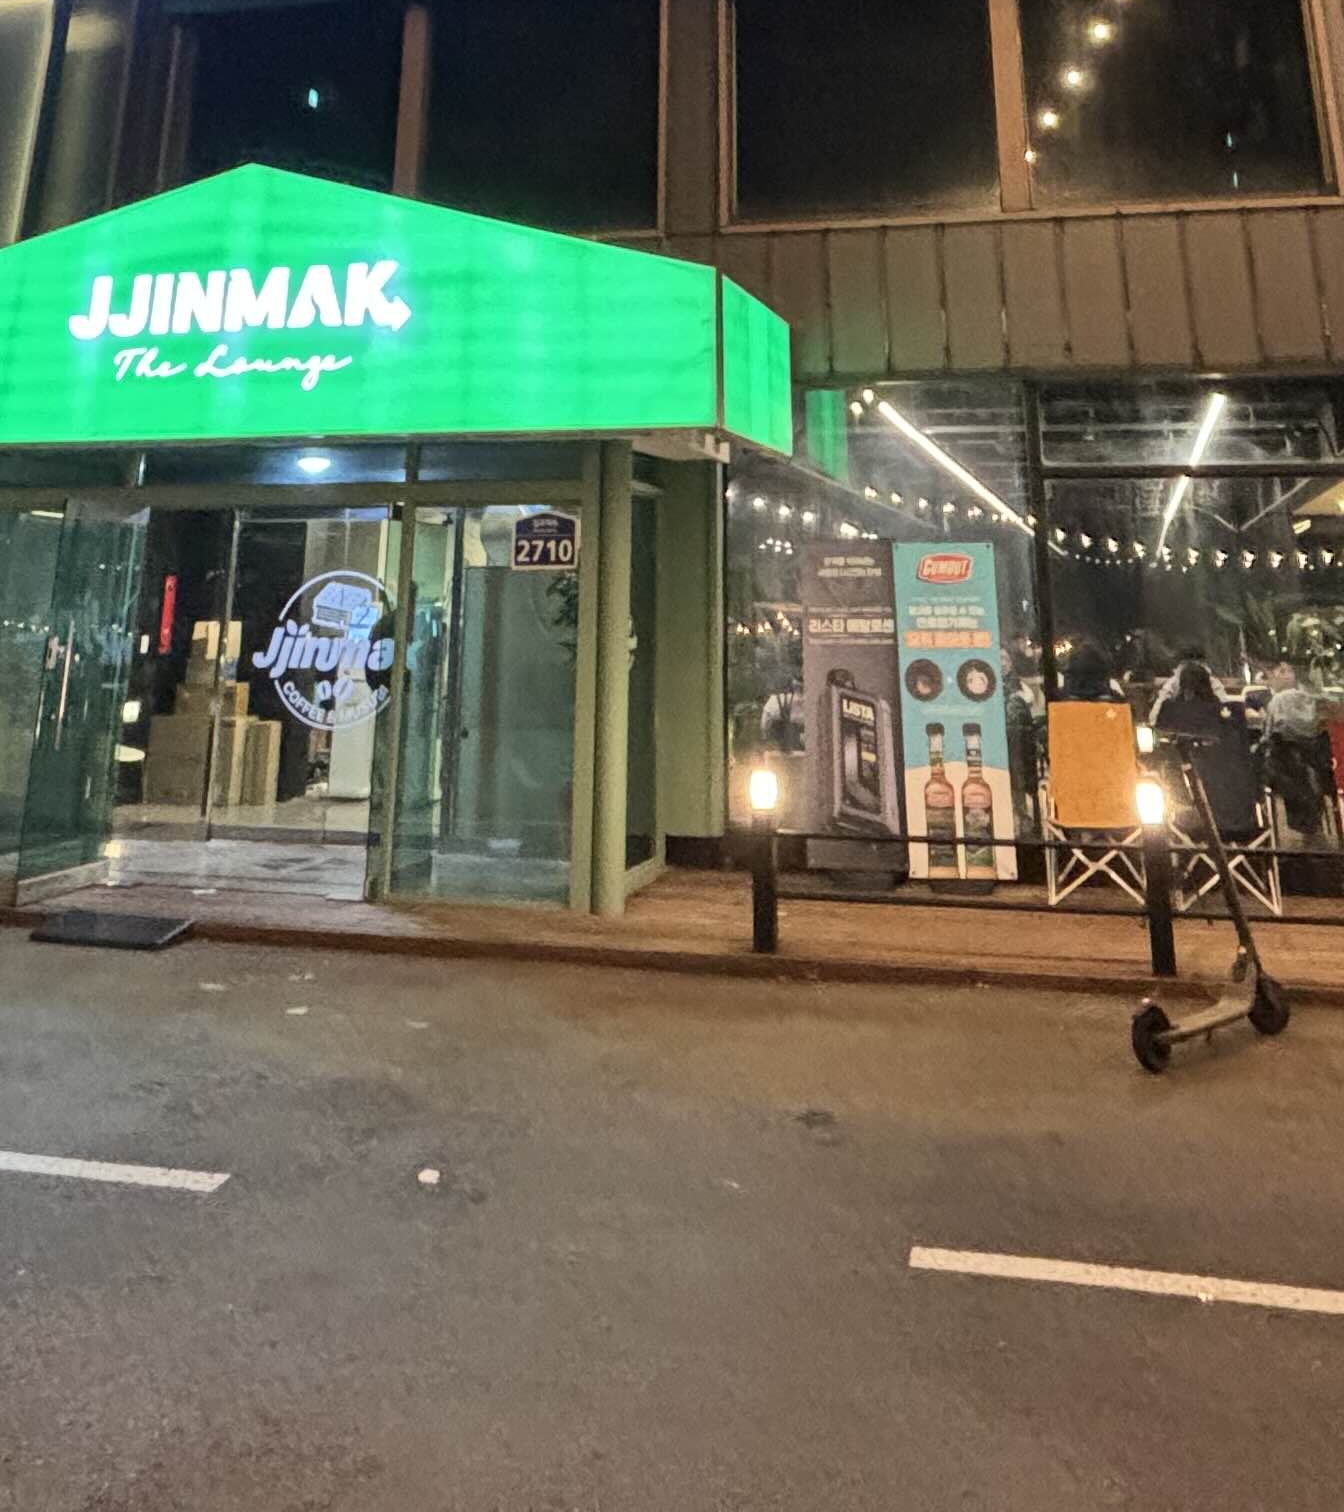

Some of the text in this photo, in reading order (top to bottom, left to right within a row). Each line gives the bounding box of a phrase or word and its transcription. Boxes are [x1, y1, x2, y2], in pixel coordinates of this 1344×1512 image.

[68, 260, 412, 339] JJINMAK
[113, 344, 352, 391] The Lounge
[517, 539, 573, 562] 2710
[252, 619, 395, 679] Jjinma
[283, 681, 326, 724] COFFEE
